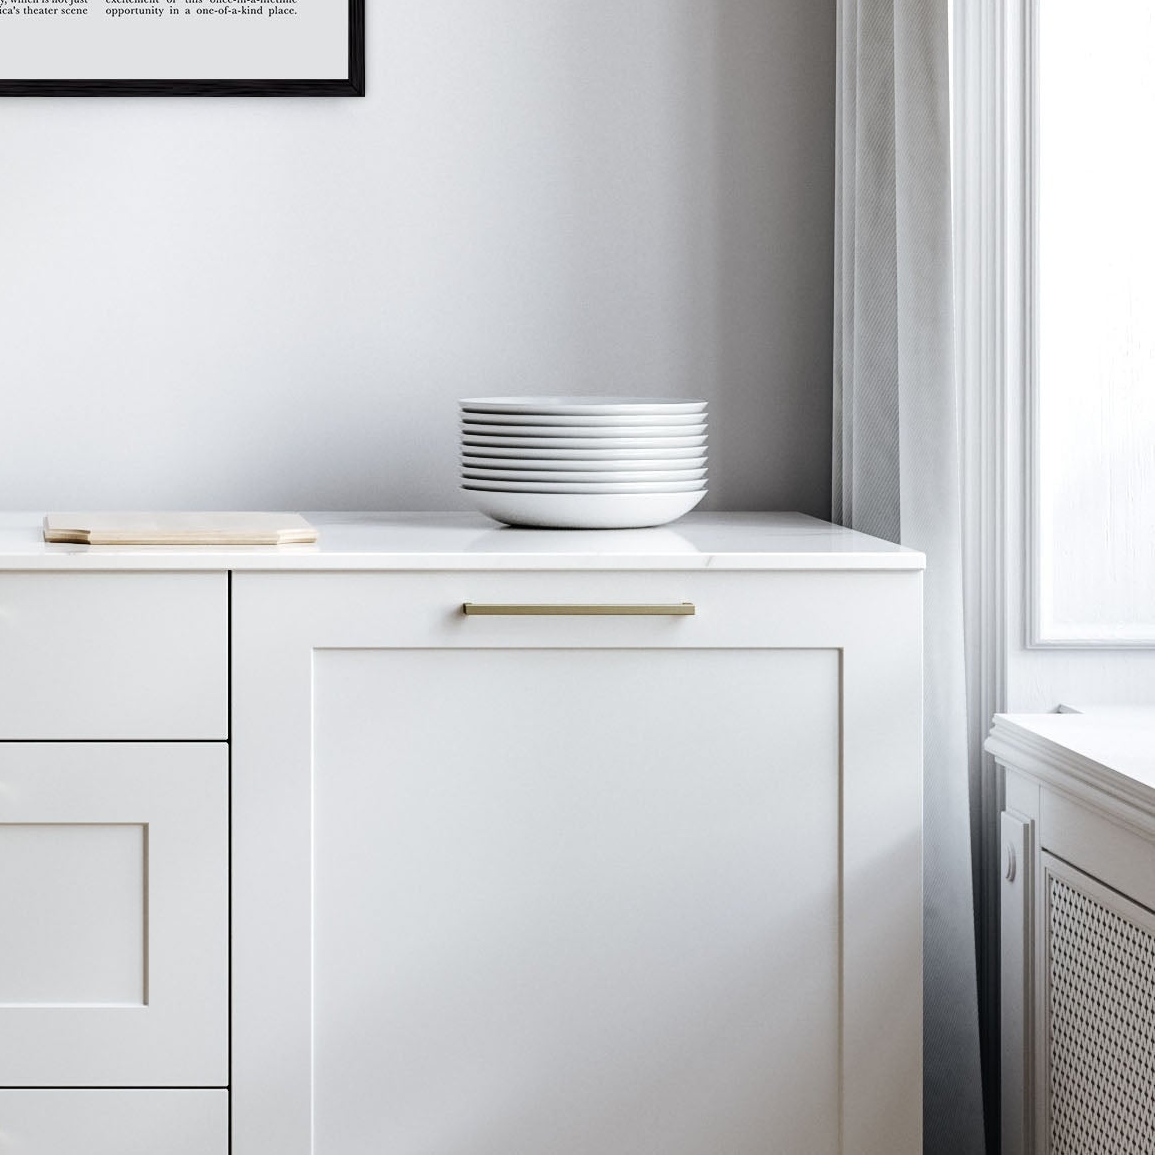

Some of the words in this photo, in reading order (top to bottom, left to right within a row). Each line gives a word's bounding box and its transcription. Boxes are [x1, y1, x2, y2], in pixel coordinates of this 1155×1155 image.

[23, 6, 58, 15] theater
[105, 6, 164, 17] opportunity
[170, 6, 179, 15] in
[196, 6, 263, 15] one-of-a-kind
[268, 6, 297, 17] place.
